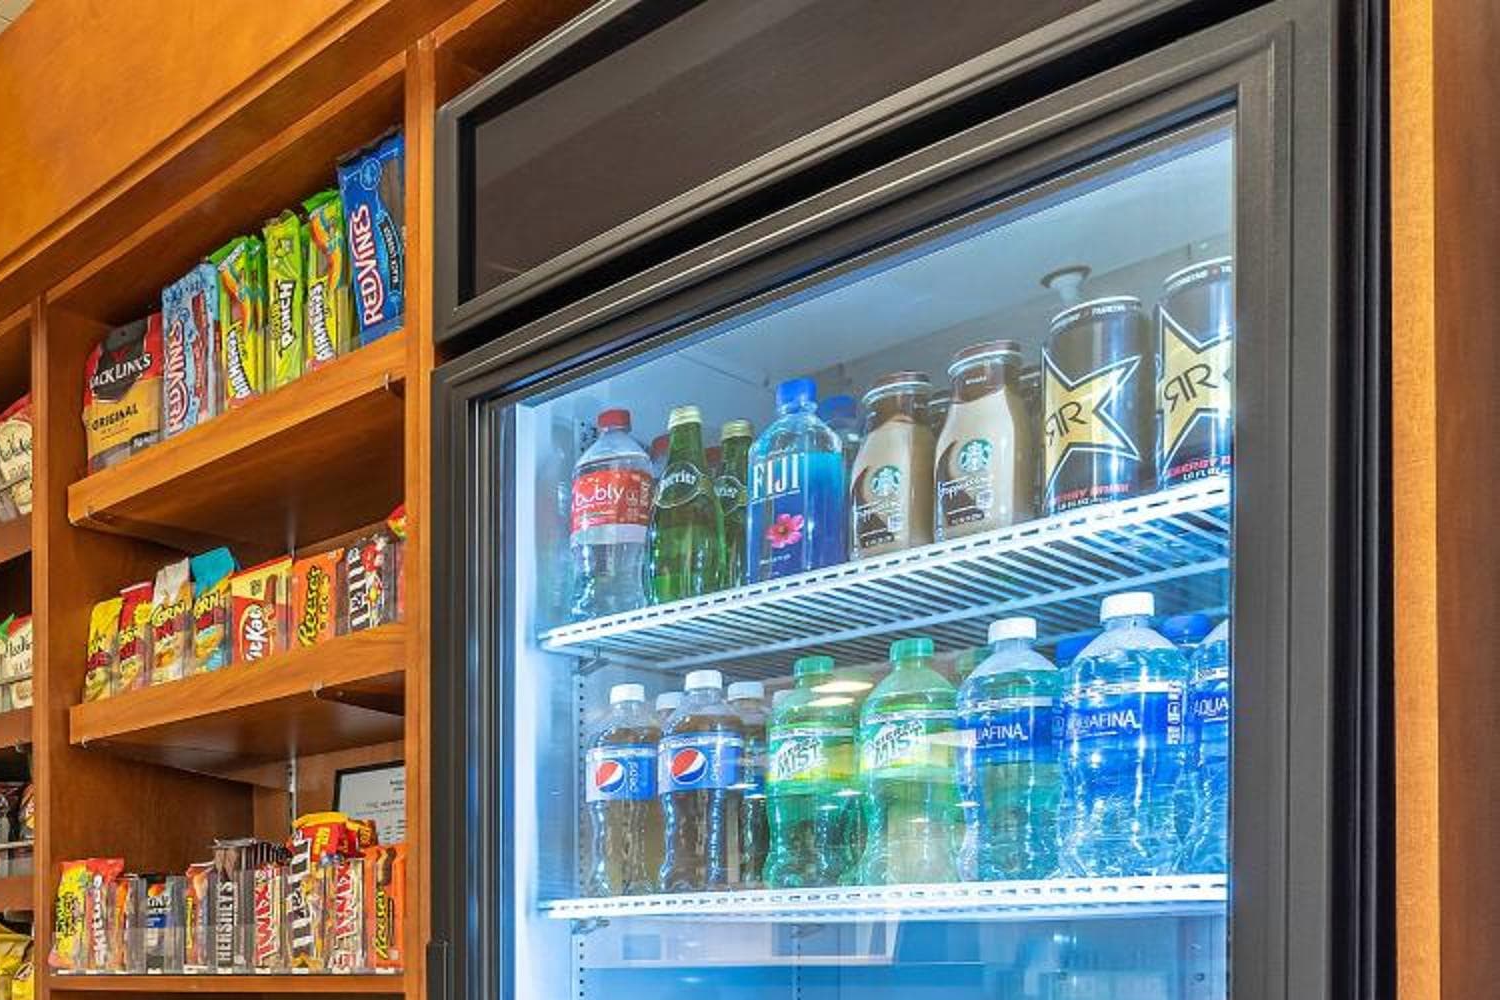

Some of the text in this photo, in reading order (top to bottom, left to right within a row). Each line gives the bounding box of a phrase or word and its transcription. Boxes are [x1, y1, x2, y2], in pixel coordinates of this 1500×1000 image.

[350, 204, 377, 273] VINES
[92, 404, 139, 431] ORIGINAL
[753, 452, 802, 499] FIJI
[1193, 696, 1229, 717] AQUA
[217, 881, 234, 962] HERSHEY'S
[254, 883, 277, 963] TWIX
